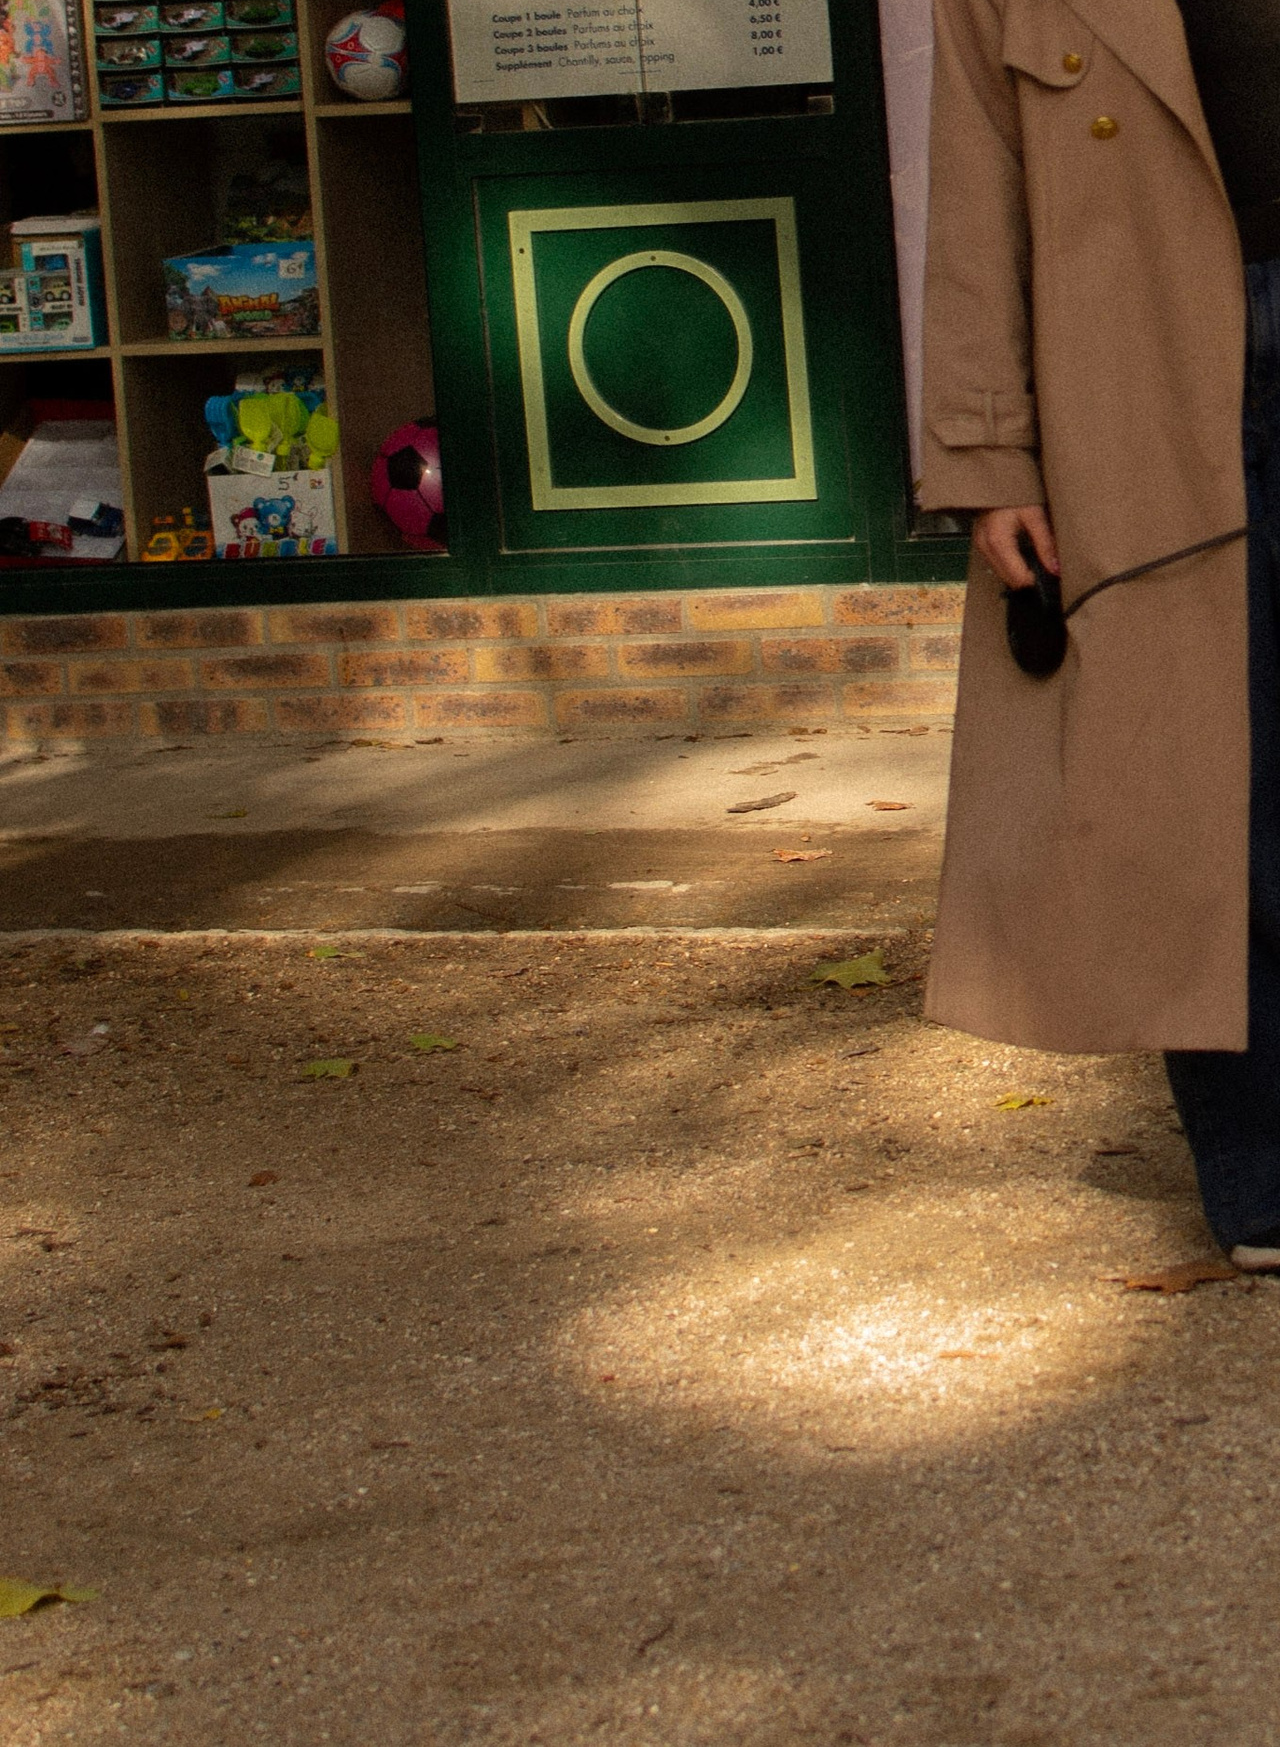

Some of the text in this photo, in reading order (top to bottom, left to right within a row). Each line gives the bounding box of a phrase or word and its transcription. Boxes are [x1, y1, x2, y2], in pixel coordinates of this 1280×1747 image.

[492, 14, 522, 24] Coupe
[534, 11, 561, 20] boule
[567, 8, 600, 18] Parfum
[617, 5, 643, 15] chox
[750, 14, 781, 24] 6,50 €
[493, 29, 523, 40] Coupe
[536, 27, 567, 36] boules
[573, 23, 610, 34] Parfums
[612, 24, 625, 32] au
[751, 30, 782, 40] 8,00 €
[494, 45, 524, 56] Coupe
[537, 43, 568, 52] boules
[574, 38, 611, 50] Parfums
[614, 40, 626, 48] au
[753, 46, 783, 56] 1,00 €
[496, 59, 552, 72] Supplément
[558, 54, 601, 67] Chantilly,
[640, 53, 675, 64] opping
